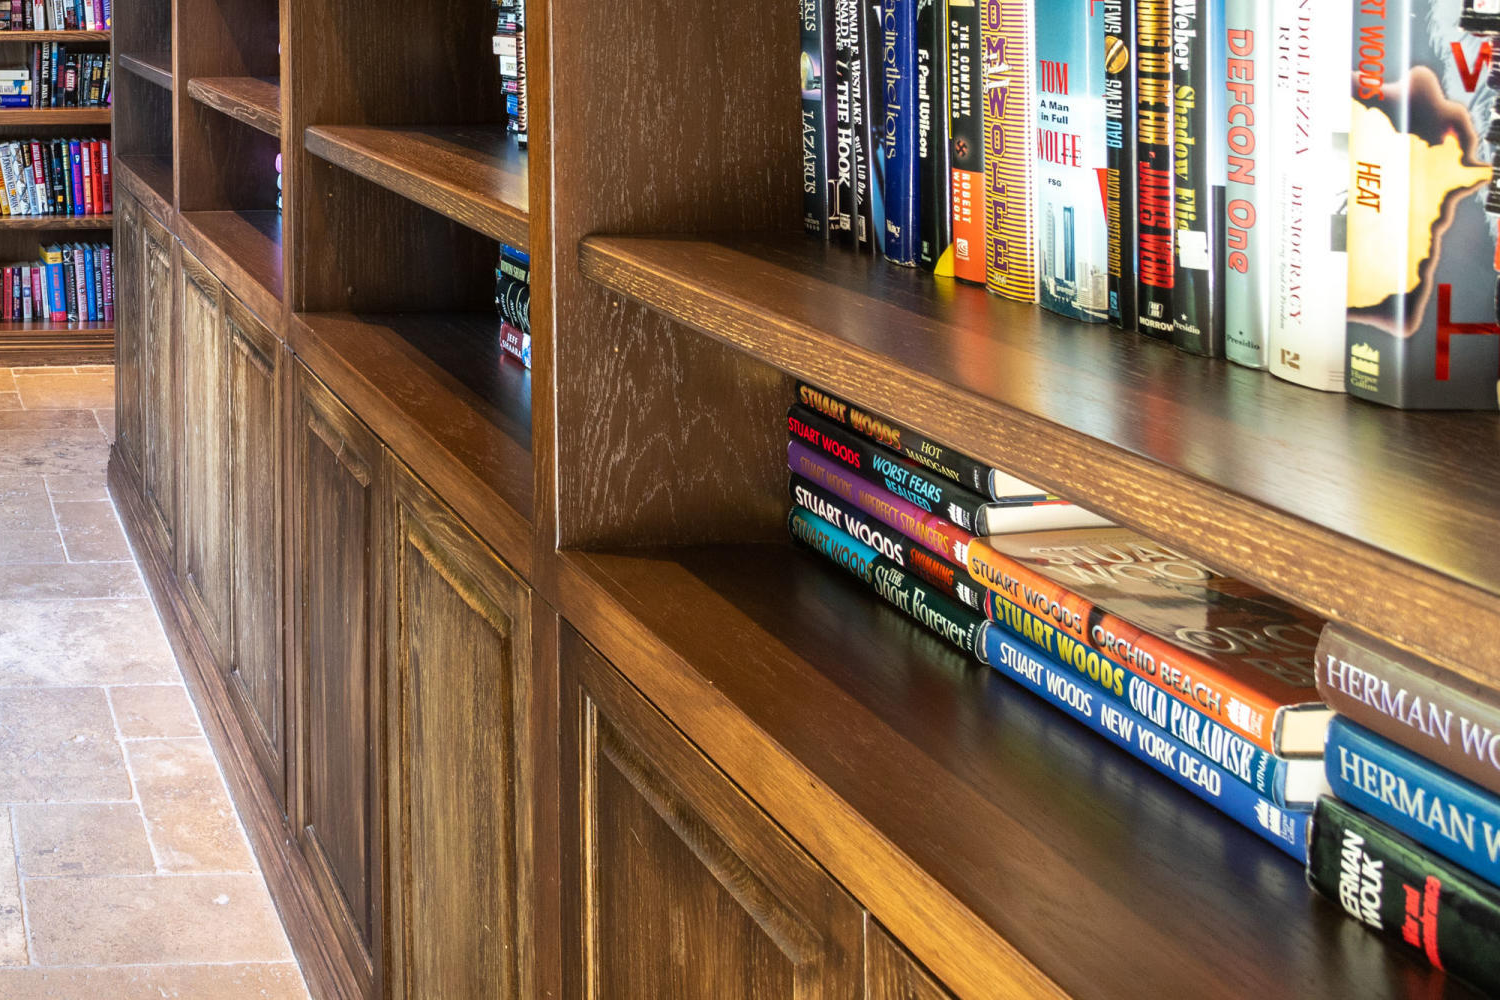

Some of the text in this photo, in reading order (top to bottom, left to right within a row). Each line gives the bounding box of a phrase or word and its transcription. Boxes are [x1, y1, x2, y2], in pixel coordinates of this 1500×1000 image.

[951, 42, 960, 119] STRANGERS
[960, 56, 971, 117] COMPANY
[1040, 60, 1069, 95] TOM
[1357, 25, 1386, 101] WOODS
[918, 65, 930, 158] Paul Wilson
[1049, 99, 1069, 112] Man
[1051, 112, 1069, 125] Full
[1173, 84, 1196, 180] Shadow
[801, 110, 816, 194] LAZARUS
[837, 128, 852, 188] HOOK
[1037, 128, 1082, 168] WOLFE
[1226, 28, 1257, 274] DEFCON One
[1356, 161, 1381, 213] HEAT
[1139, 161, 1175, 288] JAMES WEBB
[1140, 317, 1174, 332] MORROW
[1227, 335, 1261, 351] Presidio
[872, 454, 943, 504] WORST FEARS
[905, 448, 961, 483] MAHOGANY
[921, 441, 943, 459] HOT
[795, 485, 904, 567] STUART WOODS
[900, 512, 949, 554] STRANGERS
[874, 565, 968, 651] Short Forever
[972, 556, 1222, 715] STUART WOODS ORCHID BEACH
[1128, 675, 1256, 784] COLD PARADISE
[1326, 653, 1454, 746] HERMAN
[1101, 703, 1222, 798] NEW YORK DEAD
[1338, 745, 1476, 853] HERMAN
[1358, 859, 1384, 931] WOUK
